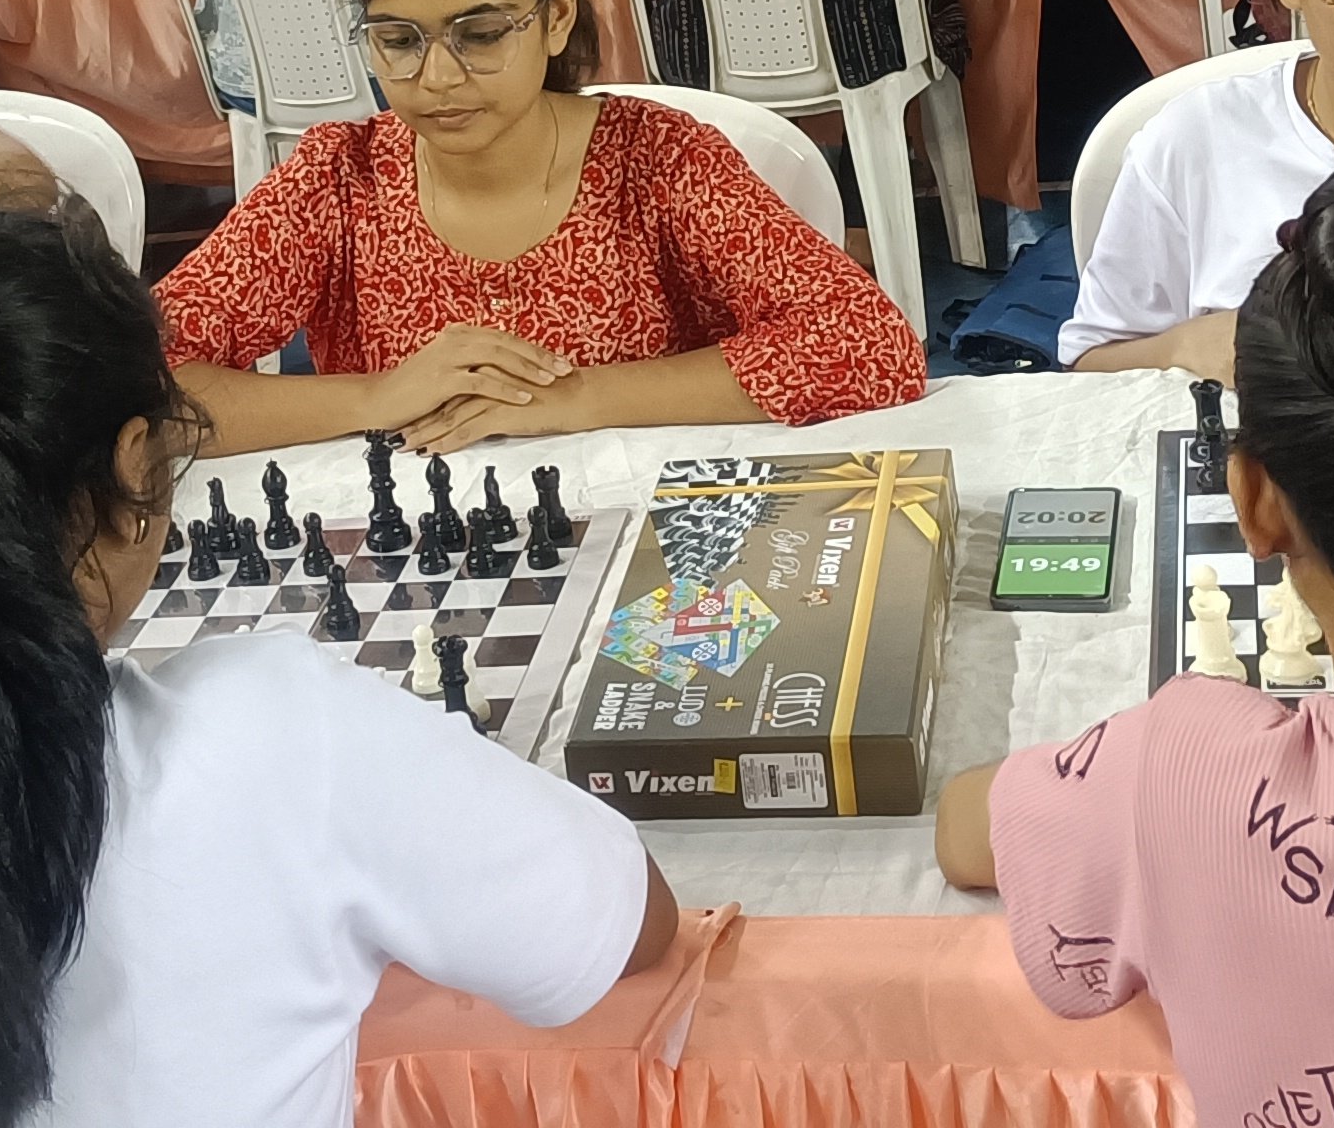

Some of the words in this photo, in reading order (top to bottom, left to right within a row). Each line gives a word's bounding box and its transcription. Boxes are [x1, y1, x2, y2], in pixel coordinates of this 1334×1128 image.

[1017, 511, 1106, 524] 20:02
[816, 536, 853, 585] Vixen
[1010, 557, 1101, 572] 19:49
[593, 682, 628, 732] LADDER
[618, 682, 657, 731] SNAKE
[770, 673, 826, 728] CHESS
[625, 770, 715, 793] Vixen
